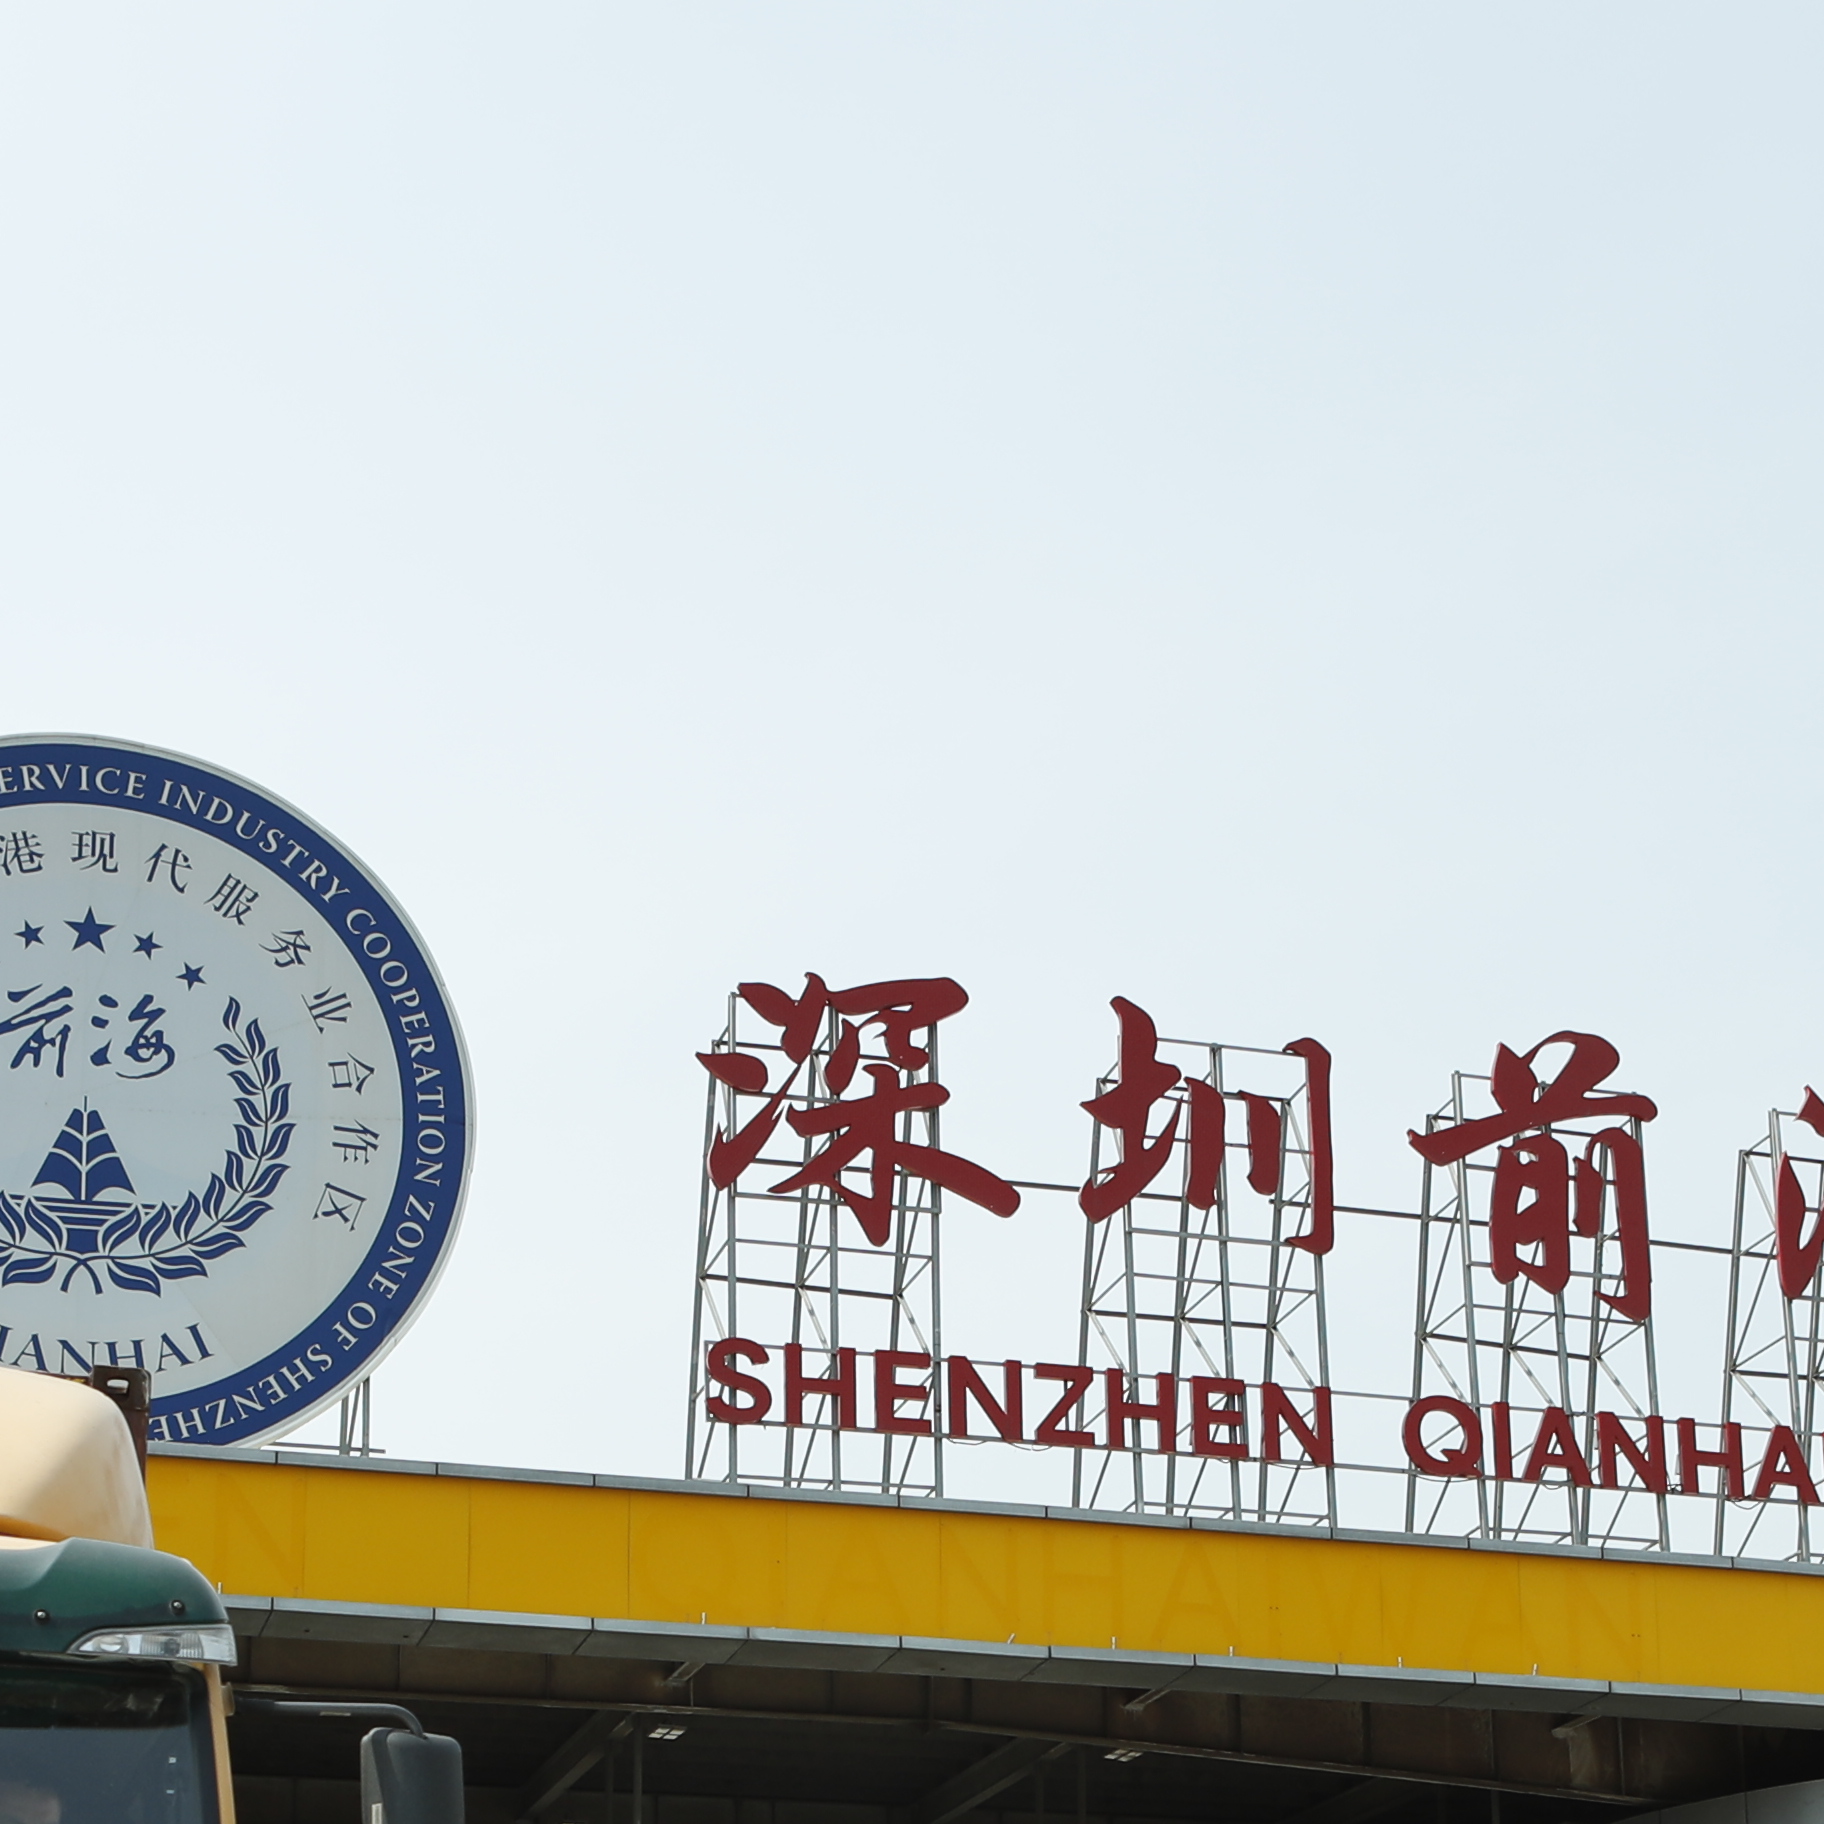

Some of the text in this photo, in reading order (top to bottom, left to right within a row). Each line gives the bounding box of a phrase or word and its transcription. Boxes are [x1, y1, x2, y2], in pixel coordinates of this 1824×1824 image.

[157, 779, 351, 903] INDUSTRY
[345, 908, 446, 1187] COOPERATION
[367, 1193, 435, 1299] ZONE
[331, 1301, 376, 1351] OF
[147, 1343, 333, 1442] SHENZHE
[705, 1337, 1335, 1468] SHENZHEN
